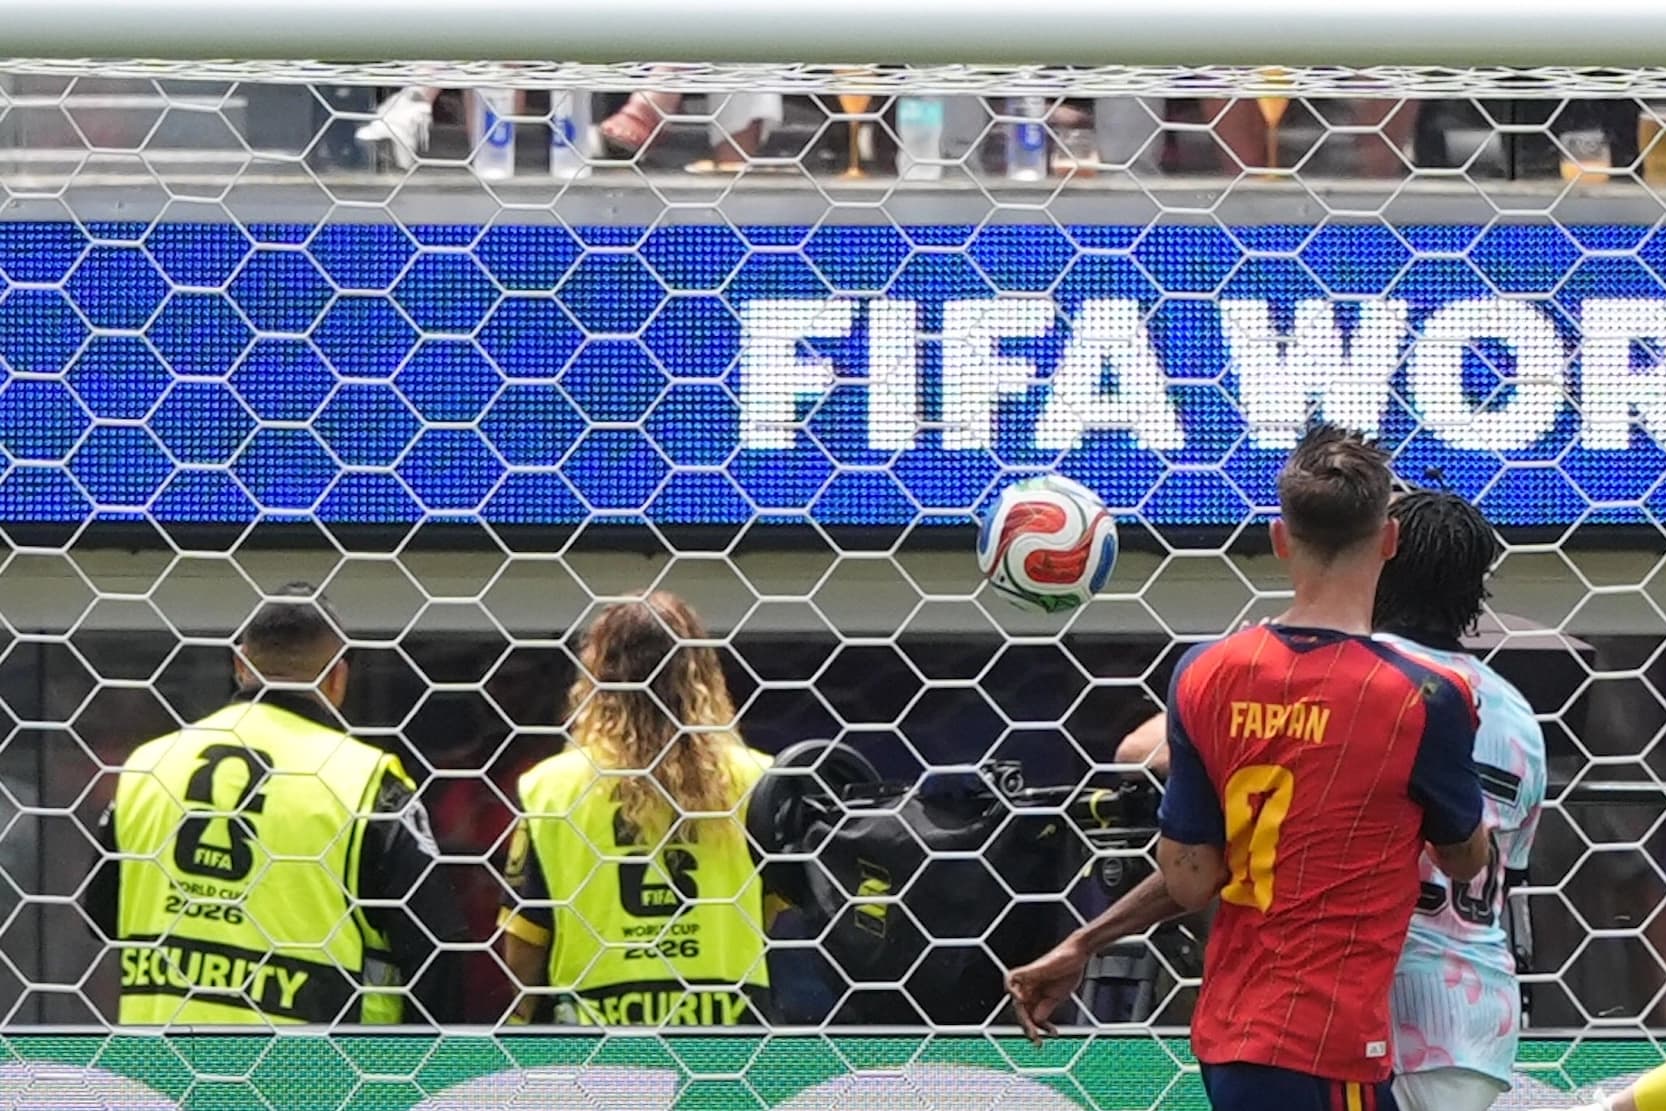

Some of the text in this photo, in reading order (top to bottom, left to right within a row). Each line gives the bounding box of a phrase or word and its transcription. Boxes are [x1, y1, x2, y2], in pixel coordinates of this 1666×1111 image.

[736, 297, 1186, 452] FIFA
[193, 847, 233, 872] FIFA
[164, 895, 244, 925] 2026
[641, 889, 679, 907] FIFA
[671, 924, 700, 936] CUP
[120, 944, 308, 1010] SECURITY
